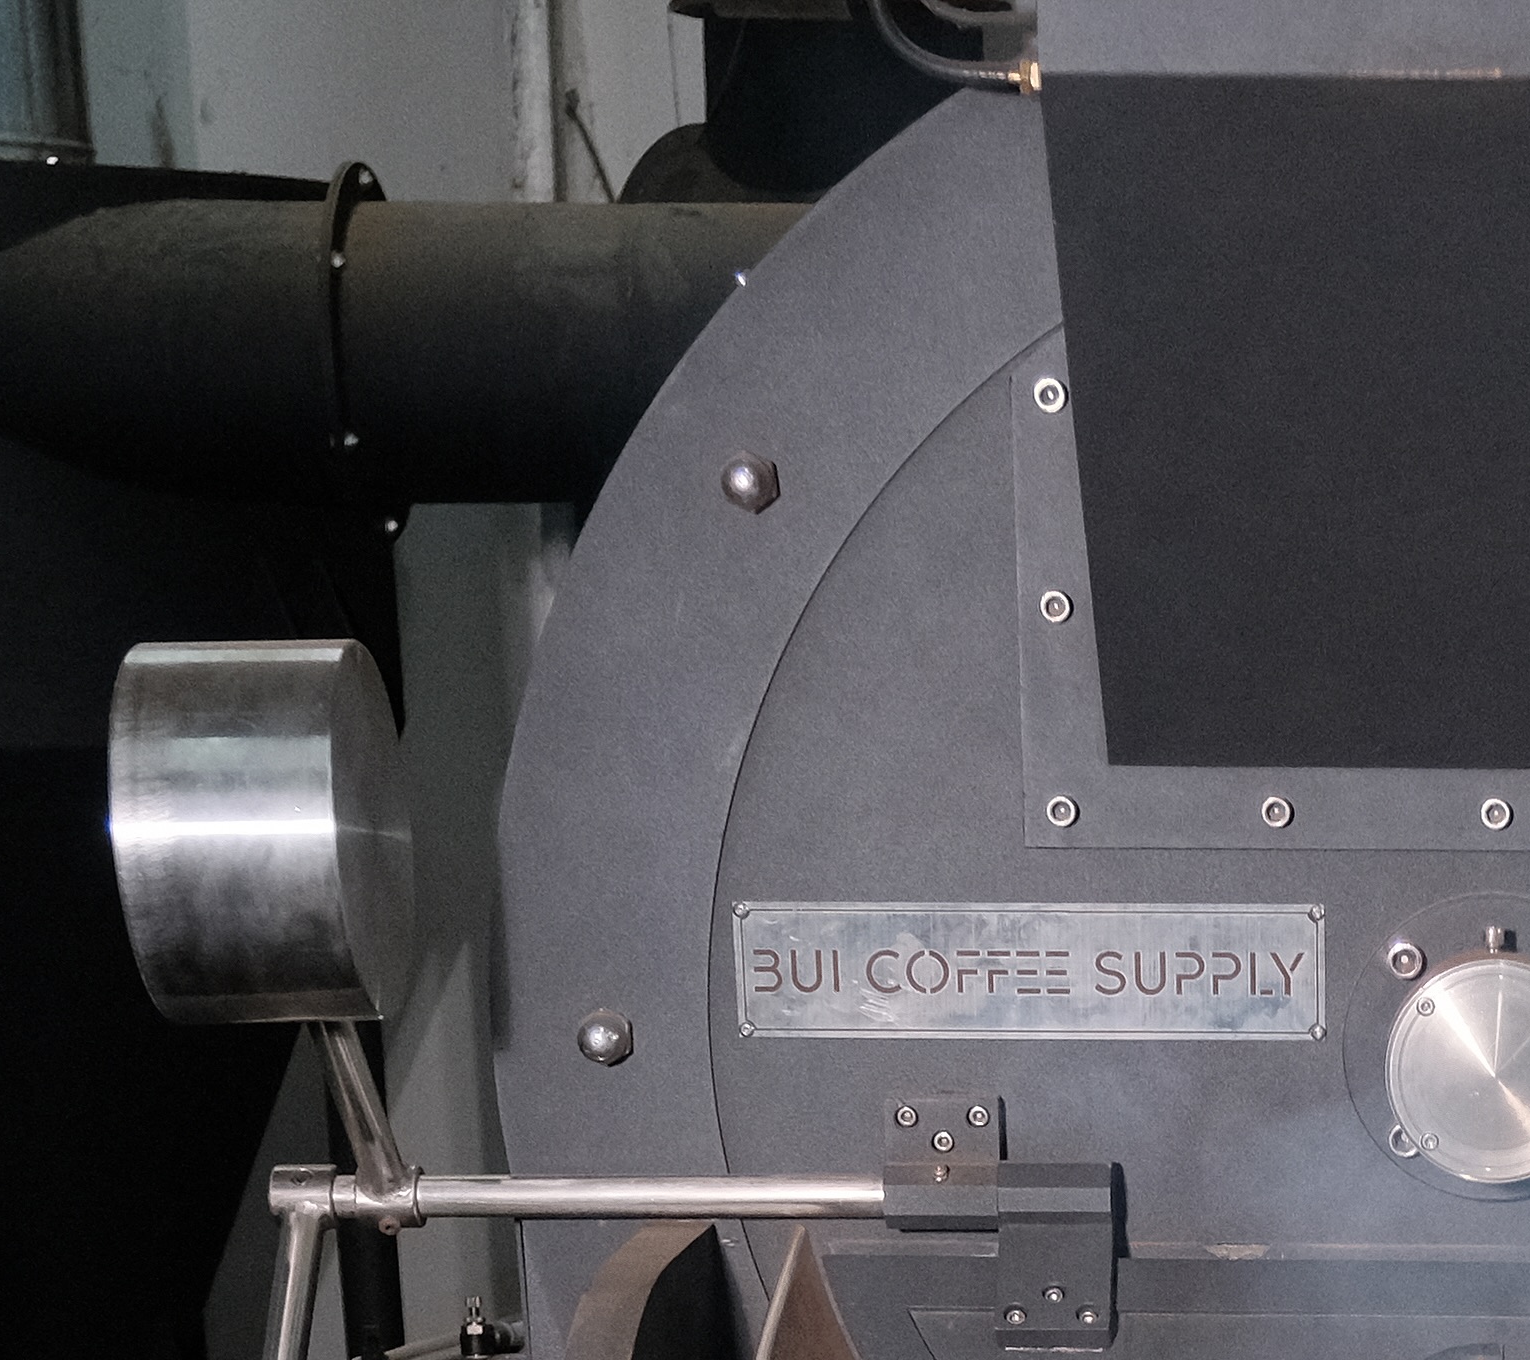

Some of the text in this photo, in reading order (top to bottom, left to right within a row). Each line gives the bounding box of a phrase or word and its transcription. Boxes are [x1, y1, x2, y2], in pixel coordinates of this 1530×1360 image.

[753, 949, 1304, 996] BUI COFFEE SUPPLY
